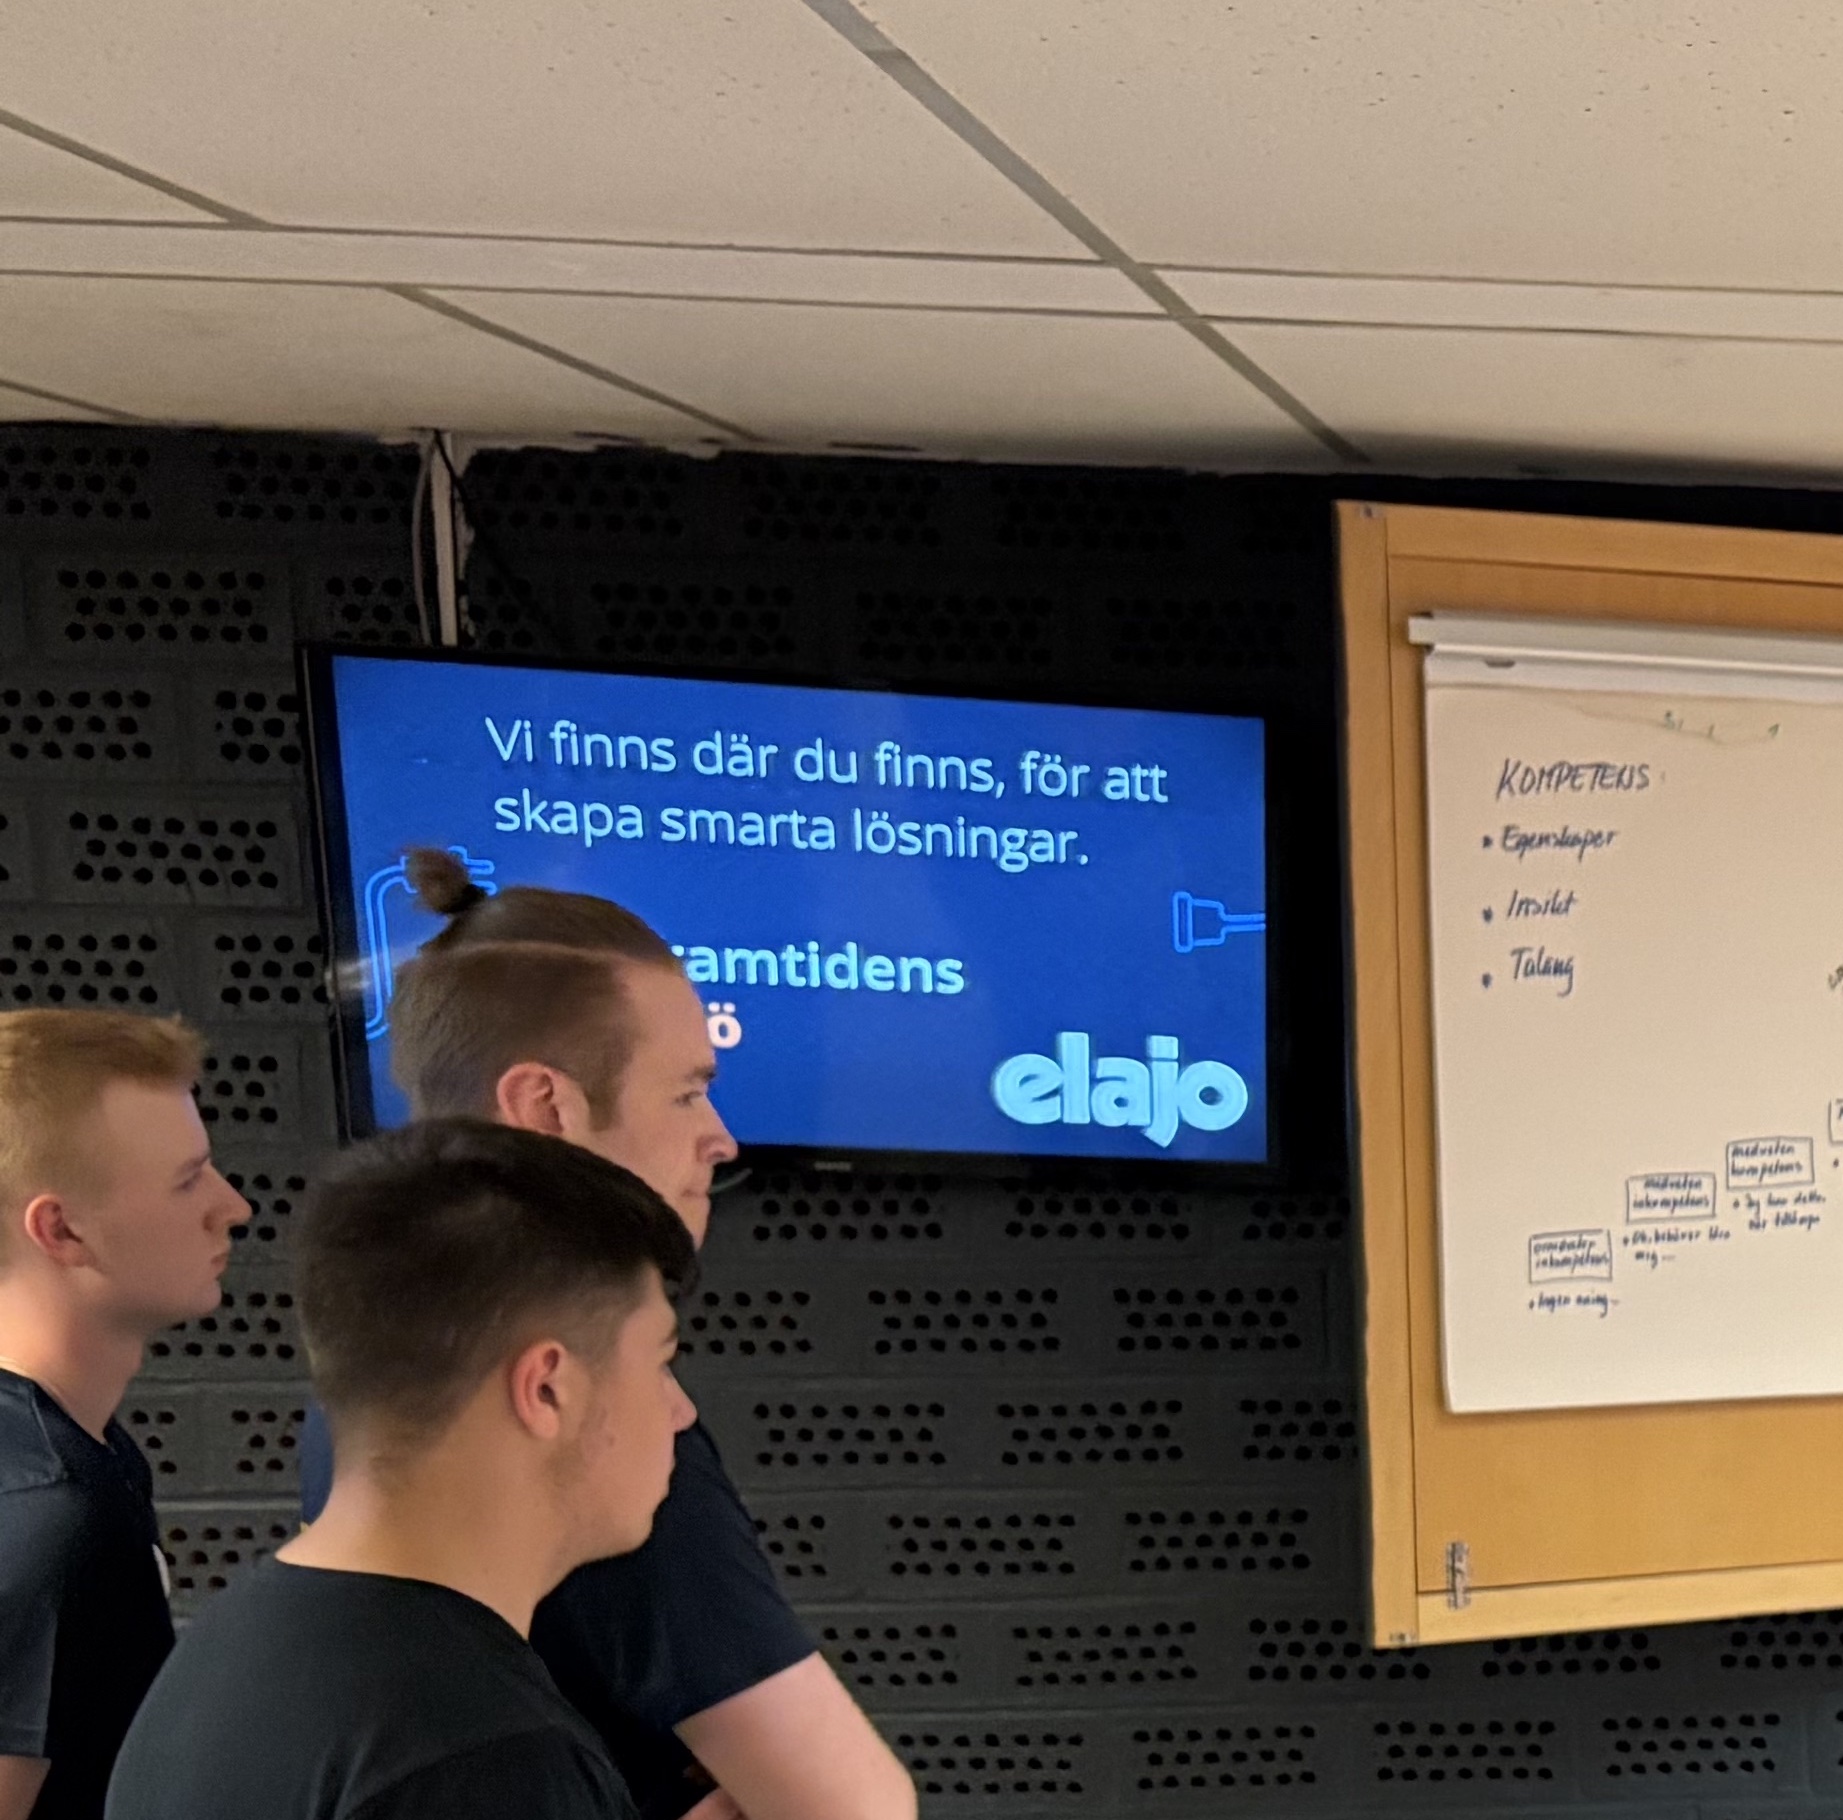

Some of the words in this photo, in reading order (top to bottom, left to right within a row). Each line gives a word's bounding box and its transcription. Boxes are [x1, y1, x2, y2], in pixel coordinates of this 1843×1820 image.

[486, 718, 535, 763] Vi
[549, 722, 678, 774] finns
[693, 731, 777, 782] där
[794, 736, 859, 785] du
[874, 742, 1005, 800] finns,
[1019, 750, 1089, 800] för
[1101, 761, 1170, 805] att
[495, 793, 644, 845] skapa
[661, 806, 837, 852] smarta
[854, 809, 1089, 872] lösningar.
[671, 938, 965, 996] amtidens
[991, 1033, 1248, 1147] elajo
